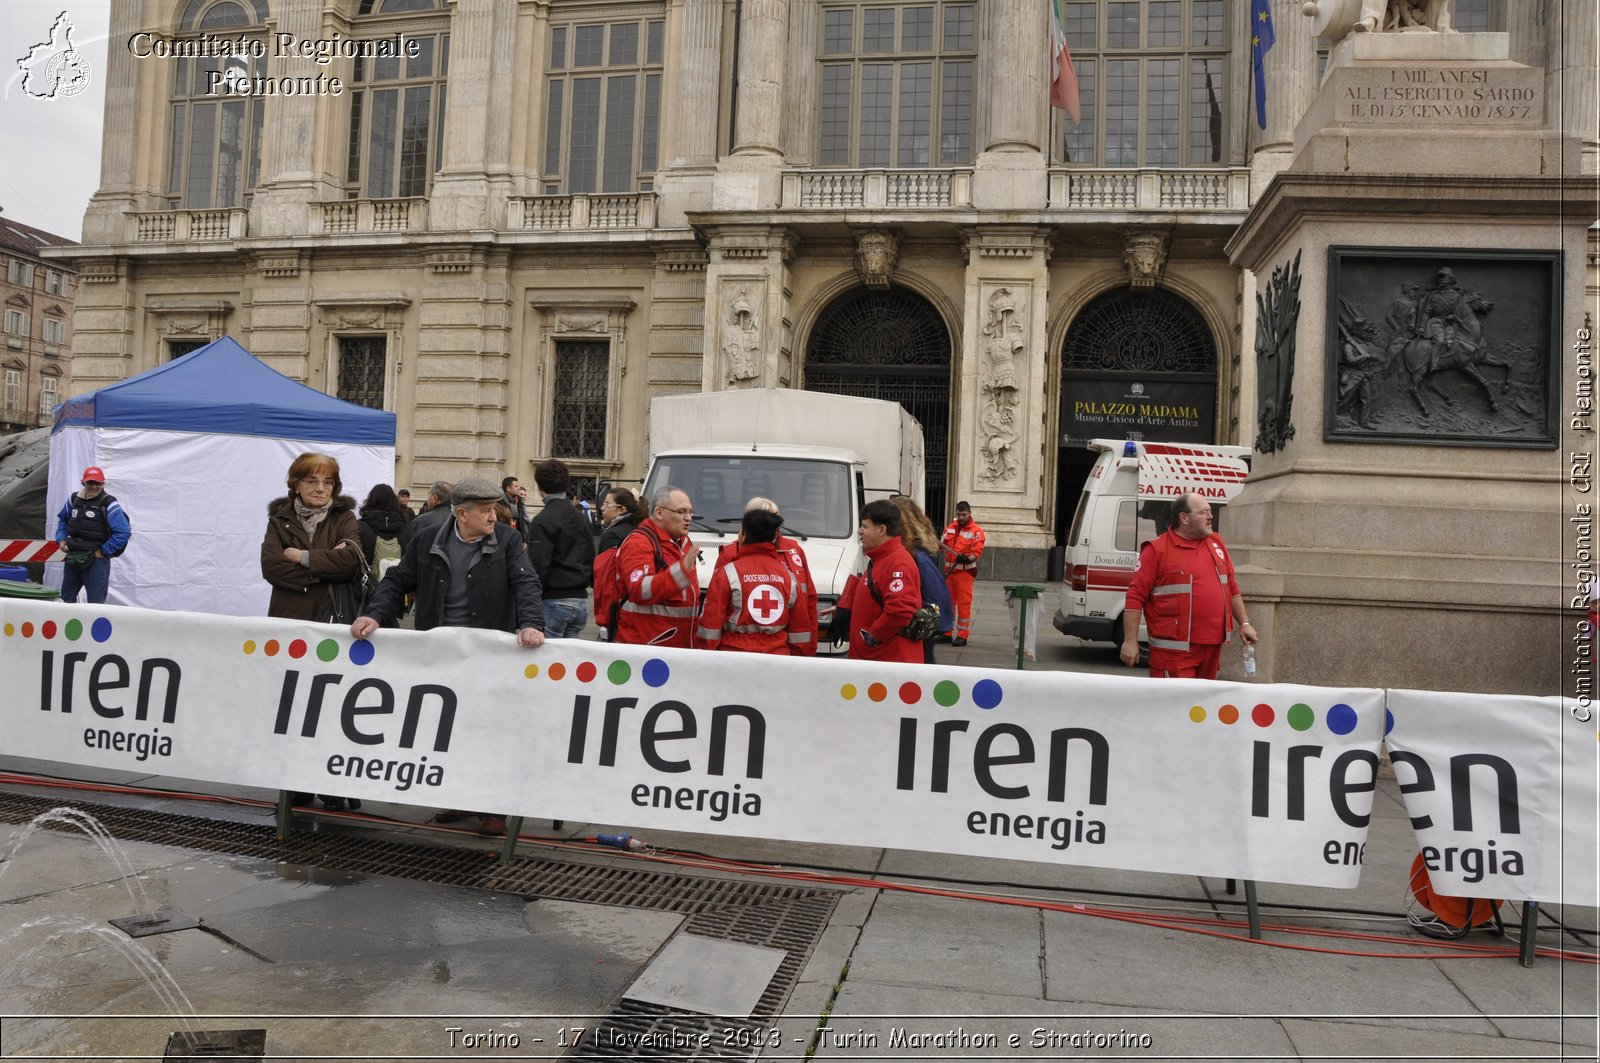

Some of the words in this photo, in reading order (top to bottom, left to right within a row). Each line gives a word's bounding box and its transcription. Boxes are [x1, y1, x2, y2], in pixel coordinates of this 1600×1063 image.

[1404, 70, 1488, 83] MILANESI
[1473, 88, 1534, 101] SARDO
[1351, 104, 1365, 117] IL
[1412, 104, 1480, 118] GENNAIO
[1074, 401, 1136, 416] PALAZZO
[1140, 404, 1199, 418] MADAMA
[1074, 413, 1104, 423] Museo
[1106, 414, 1135, 424] Civico
[1137, 415, 1166, 425] d'Arte
[1168, 418, 1199, 427] Antica
[1094, 555, 1114, 565] Dono
[1115, 556, 1134, 566] della
[41, 650, 182, 724] iren
[274, 670, 458, 753] iren
[84, 727, 173, 762] energia
[567, 694, 766, 779] iren
[326, 747, 446, 792] energia
[896, 717, 1110, 806] iren
[631, 783, 762, 822] energia
[967, 810, 1106, 851] energia
